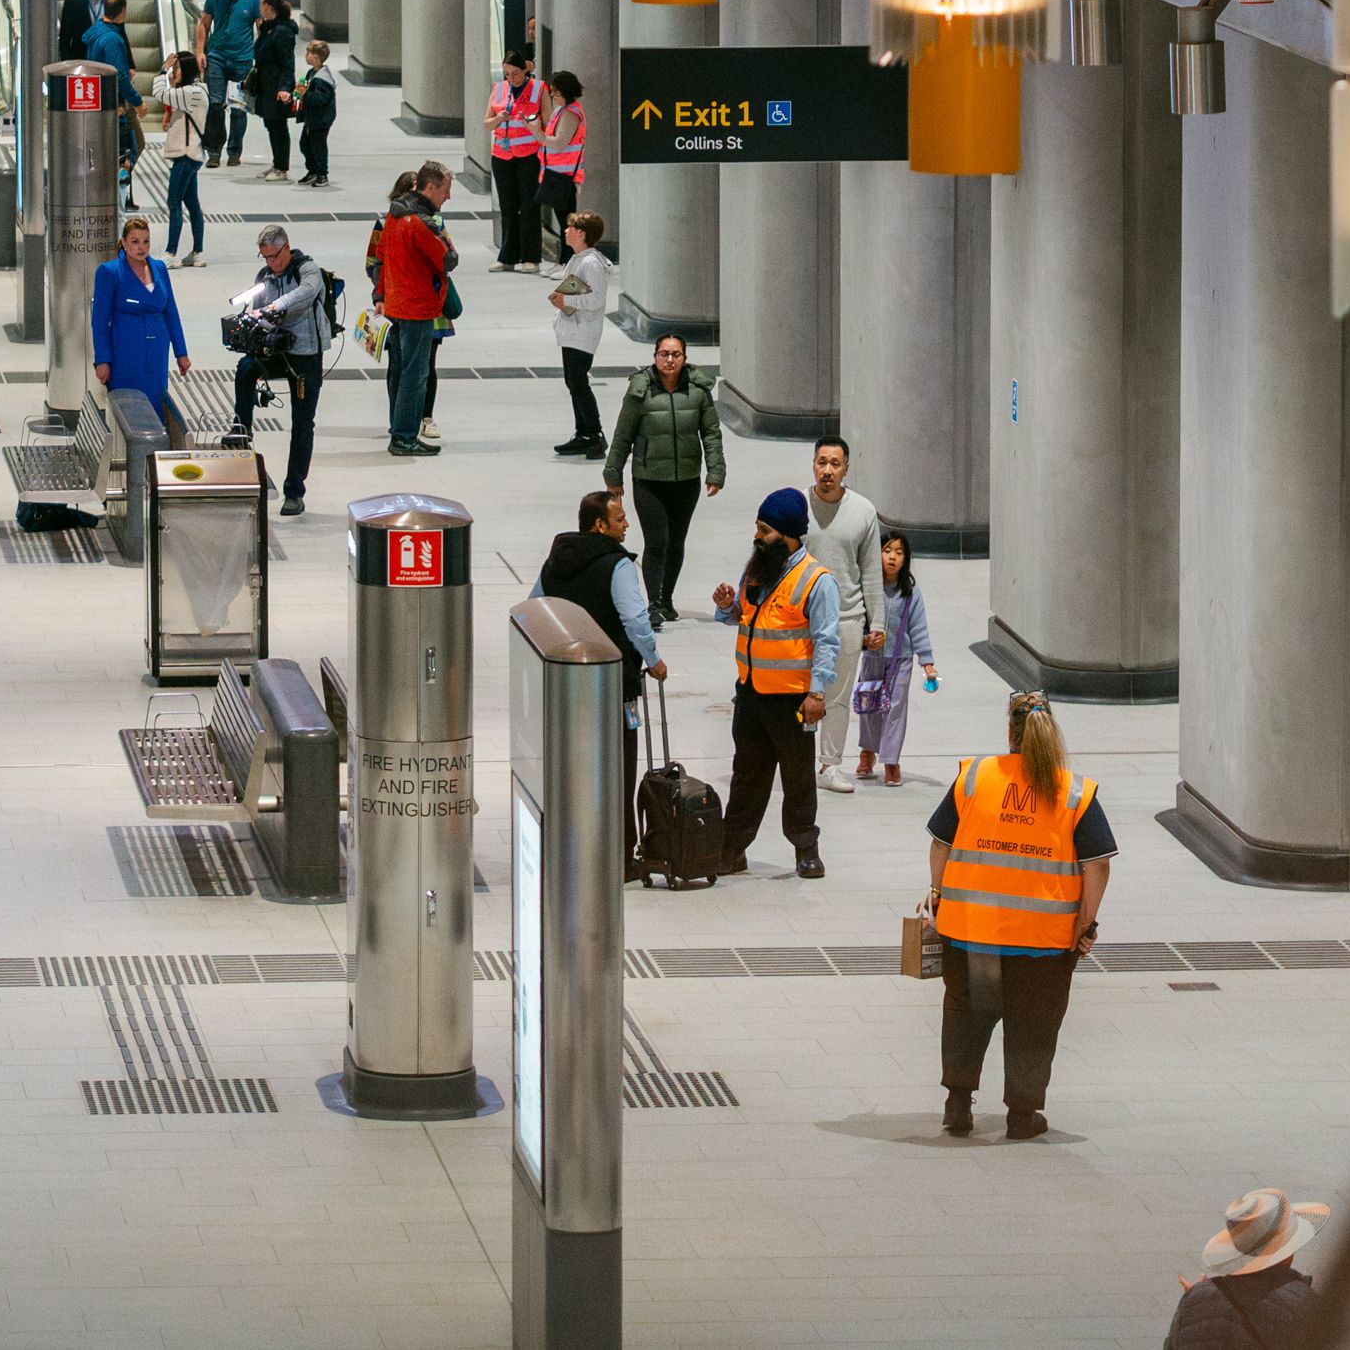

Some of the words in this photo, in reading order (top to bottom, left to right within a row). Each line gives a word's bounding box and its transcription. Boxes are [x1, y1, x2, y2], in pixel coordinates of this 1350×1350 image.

[675, 101, 731, 127] Exit
[738, 101, 754, 127] 1
[674, 136, 723, 150] Collins
[727, 136, 743, 150] St
[62, 229, 84, 239] AND
[87, 228, 110, 239] FIRE
[363, 753, 393, 771] FIRE
[399, 753, 472, 772] HYDRANT
[378, 779, 415, 795] AND
[421, 778, 458, 795] FIRE
[999, 812, 1035, 826] METRO
[977, 838, 1018, 853] CUSTOMER
[1019, 843, 1053, 858] SERVICE
